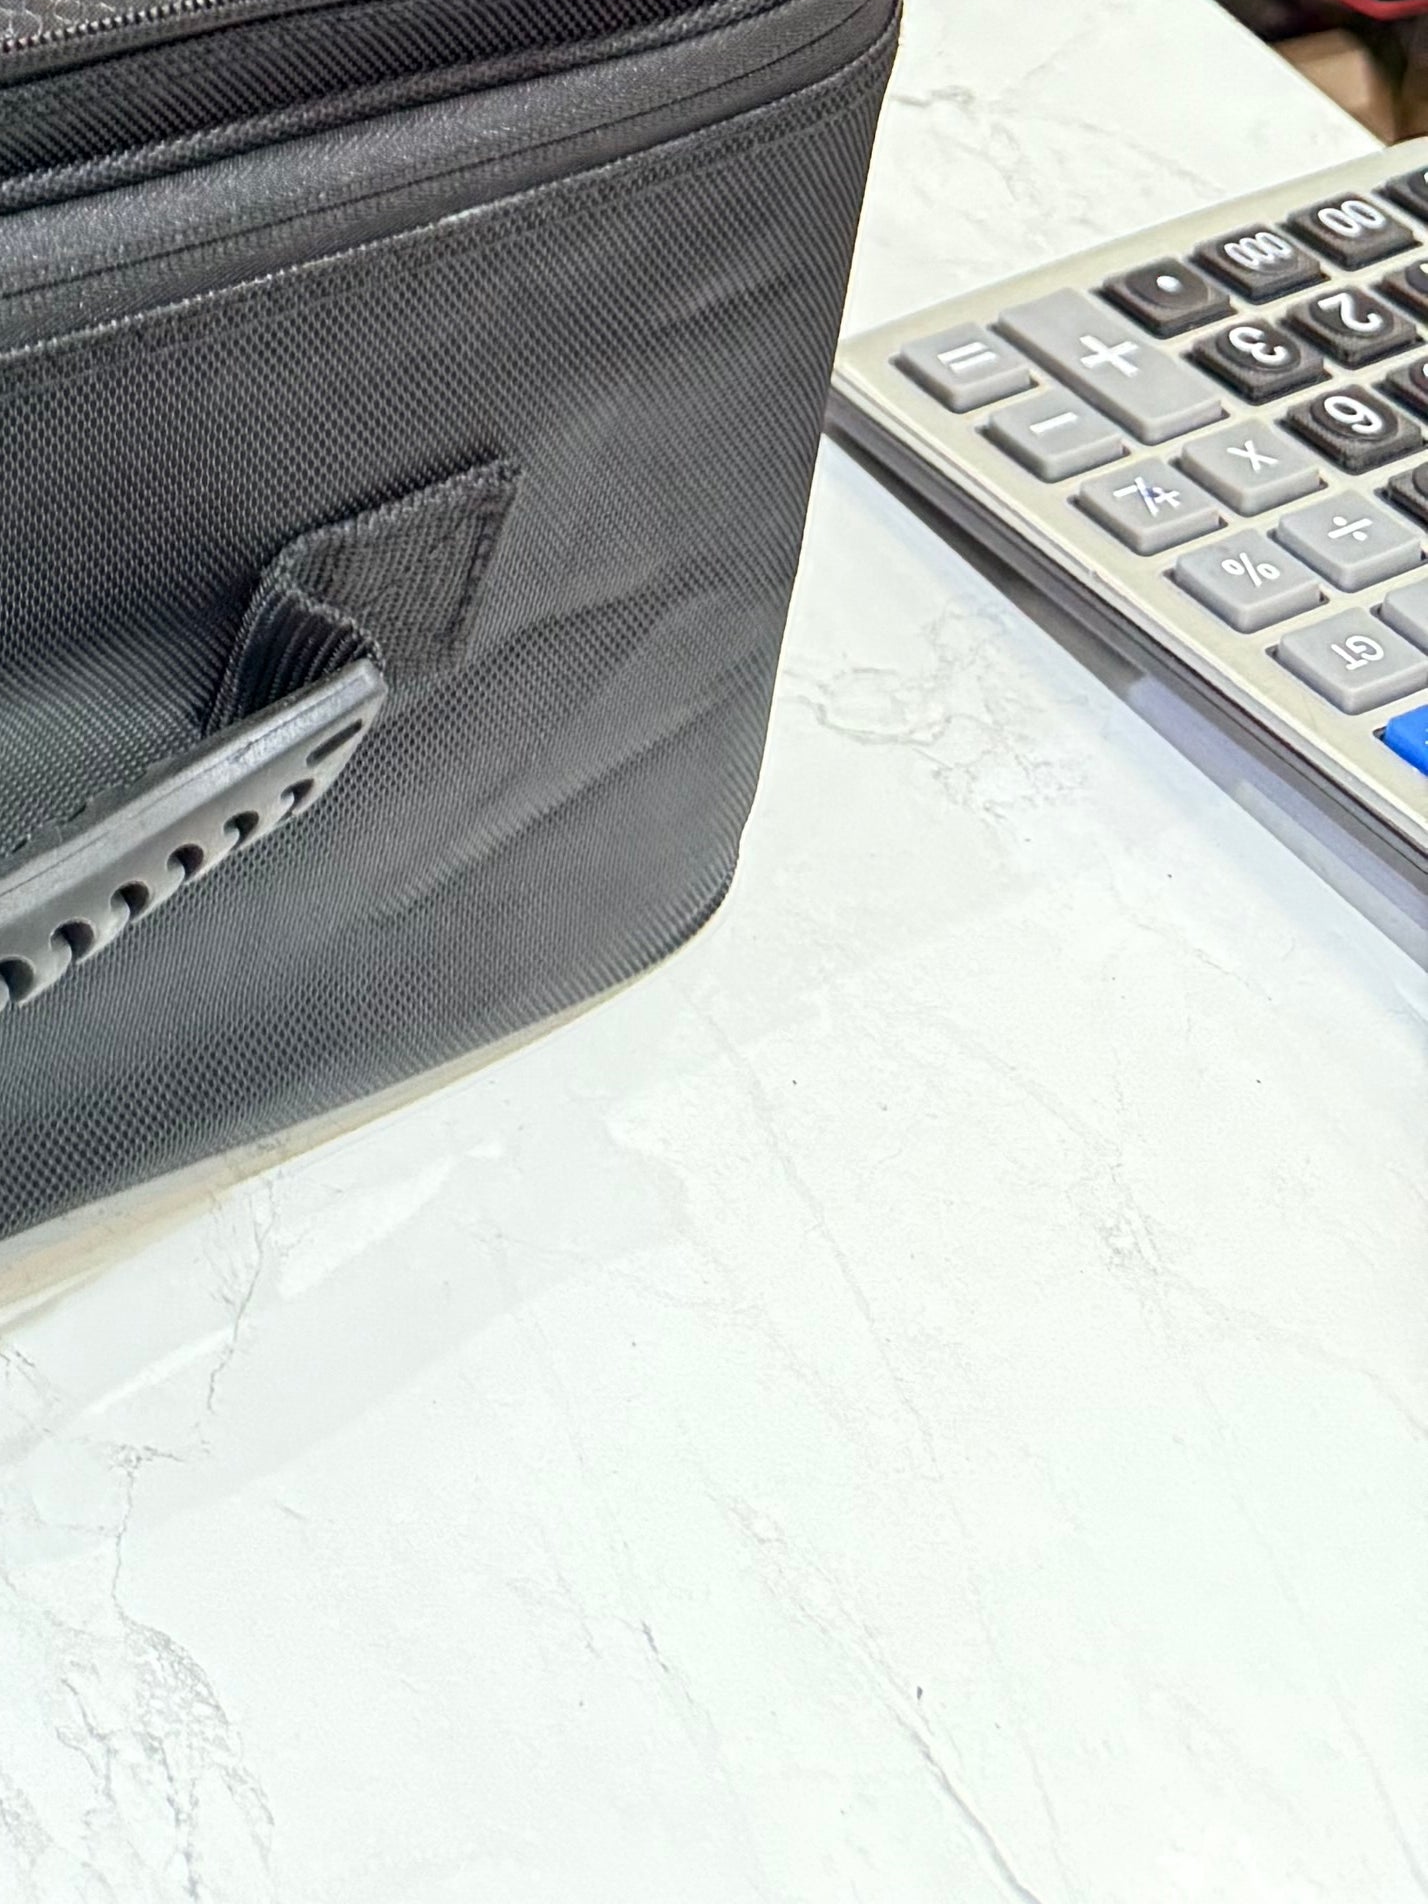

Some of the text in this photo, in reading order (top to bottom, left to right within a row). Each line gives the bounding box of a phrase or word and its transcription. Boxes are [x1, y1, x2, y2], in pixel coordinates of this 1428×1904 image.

[1317, 199, 1386, 238] 00
[1224, 231, 1293, 271] 000
[1317, 292, 1384, 333] 2
[1228, 326, 1289, 364] 3
[1323, 395, 1384, 434] 6
[1330, 635, 1385, 670] GT
